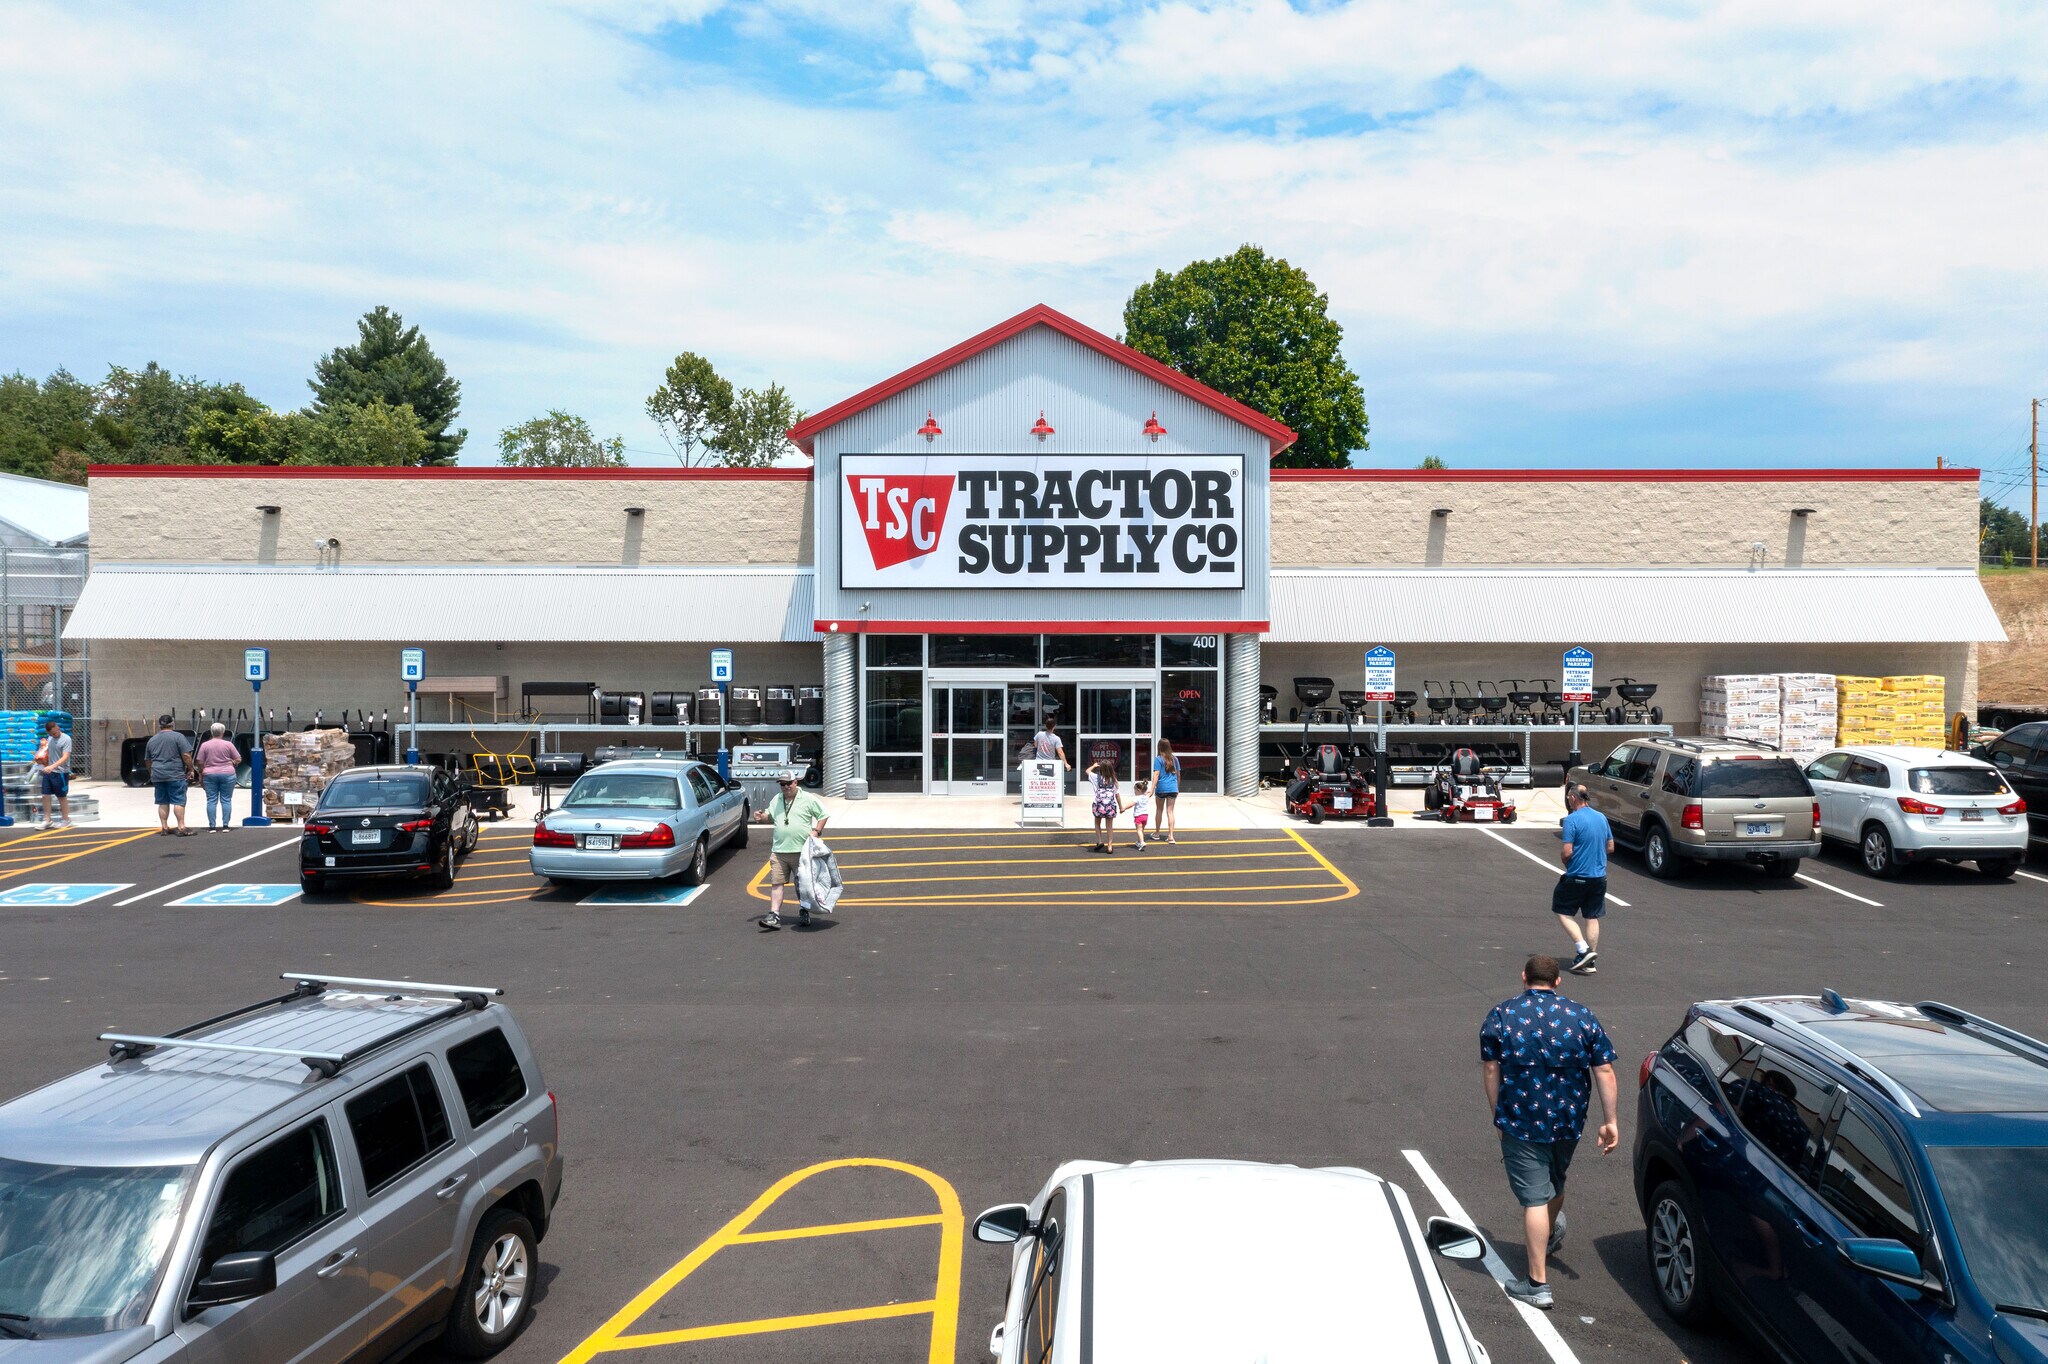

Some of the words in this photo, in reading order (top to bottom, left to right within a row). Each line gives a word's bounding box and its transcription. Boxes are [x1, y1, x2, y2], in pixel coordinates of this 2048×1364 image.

[859, 478, 936, 551] TSC
[958, 468, 1235, 520] TRACTOR
[958, 523, 1168, 575] SUPPLY
[1193, 636, 1216, 648] 400
[1179, 690, 1201, 699] OPEN
